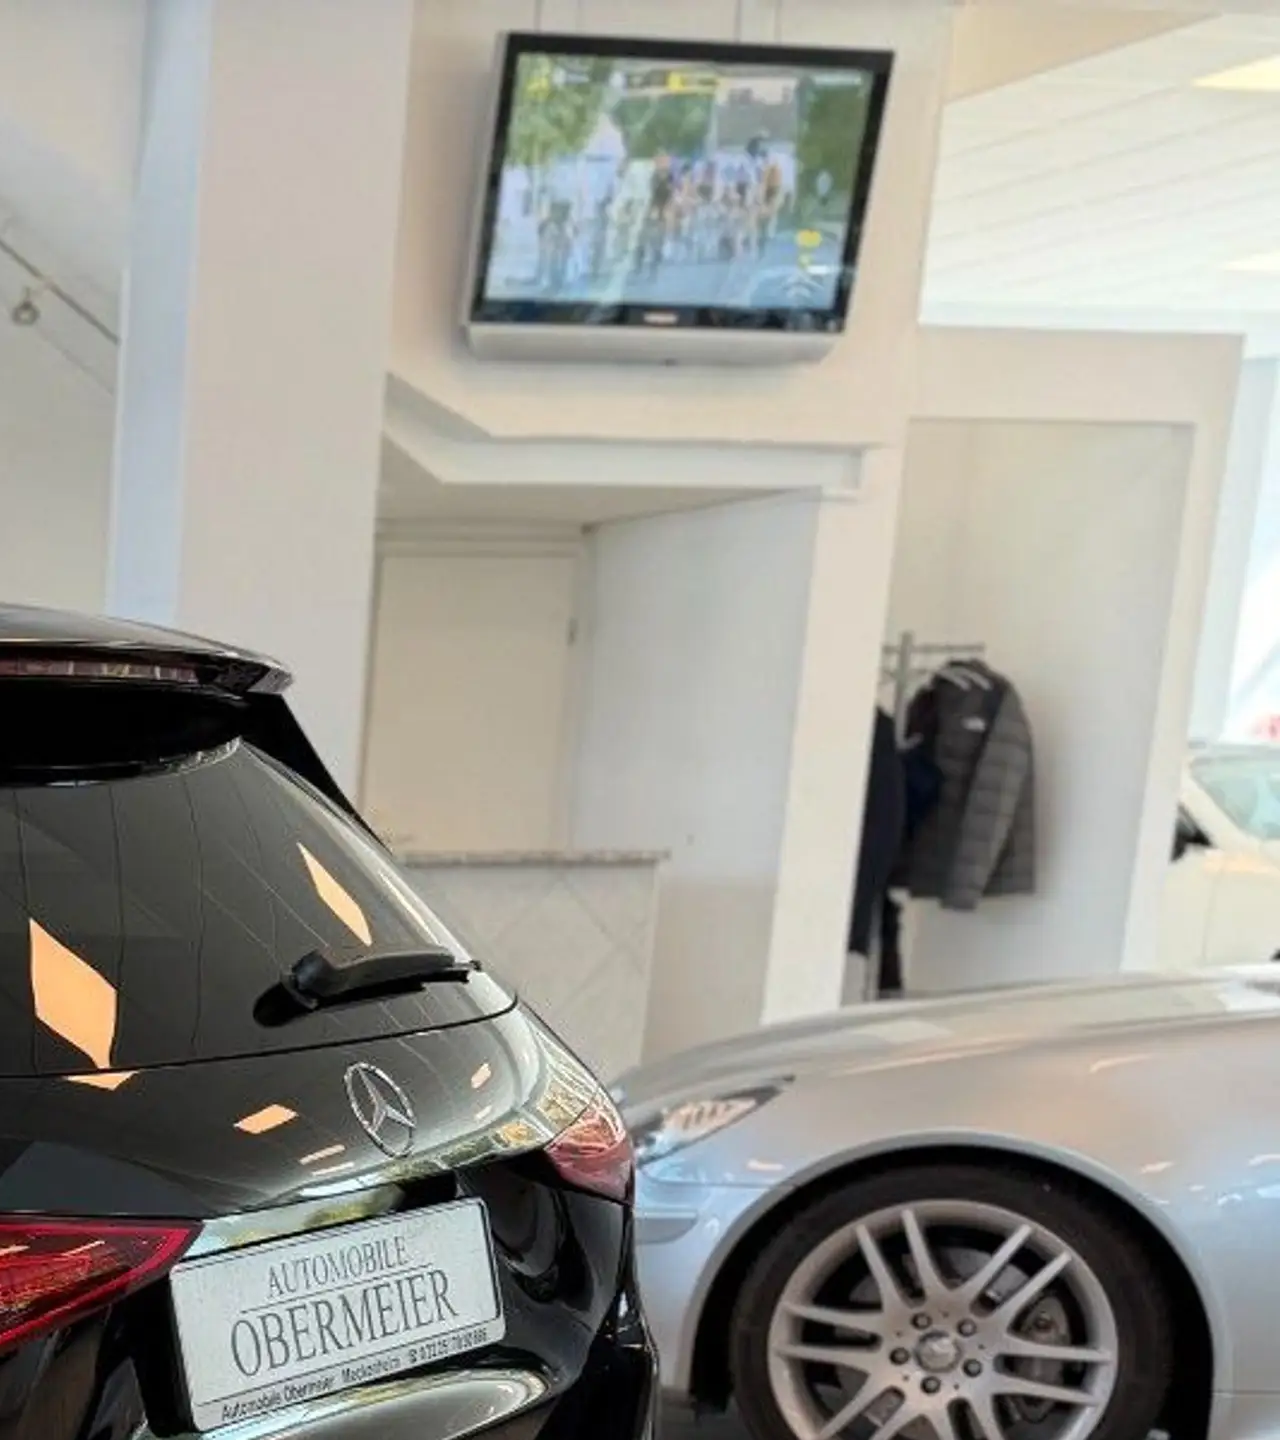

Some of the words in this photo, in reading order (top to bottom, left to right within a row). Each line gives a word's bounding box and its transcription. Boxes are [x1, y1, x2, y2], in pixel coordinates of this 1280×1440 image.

[268, 1236, 408, 1298] AUTOMOBILE
[231, 1269, 459, 1377] OBERMEIER
[222, 1388, 280, 1421] Automobile
[283, 1377, 333, 1401] Obermeier
